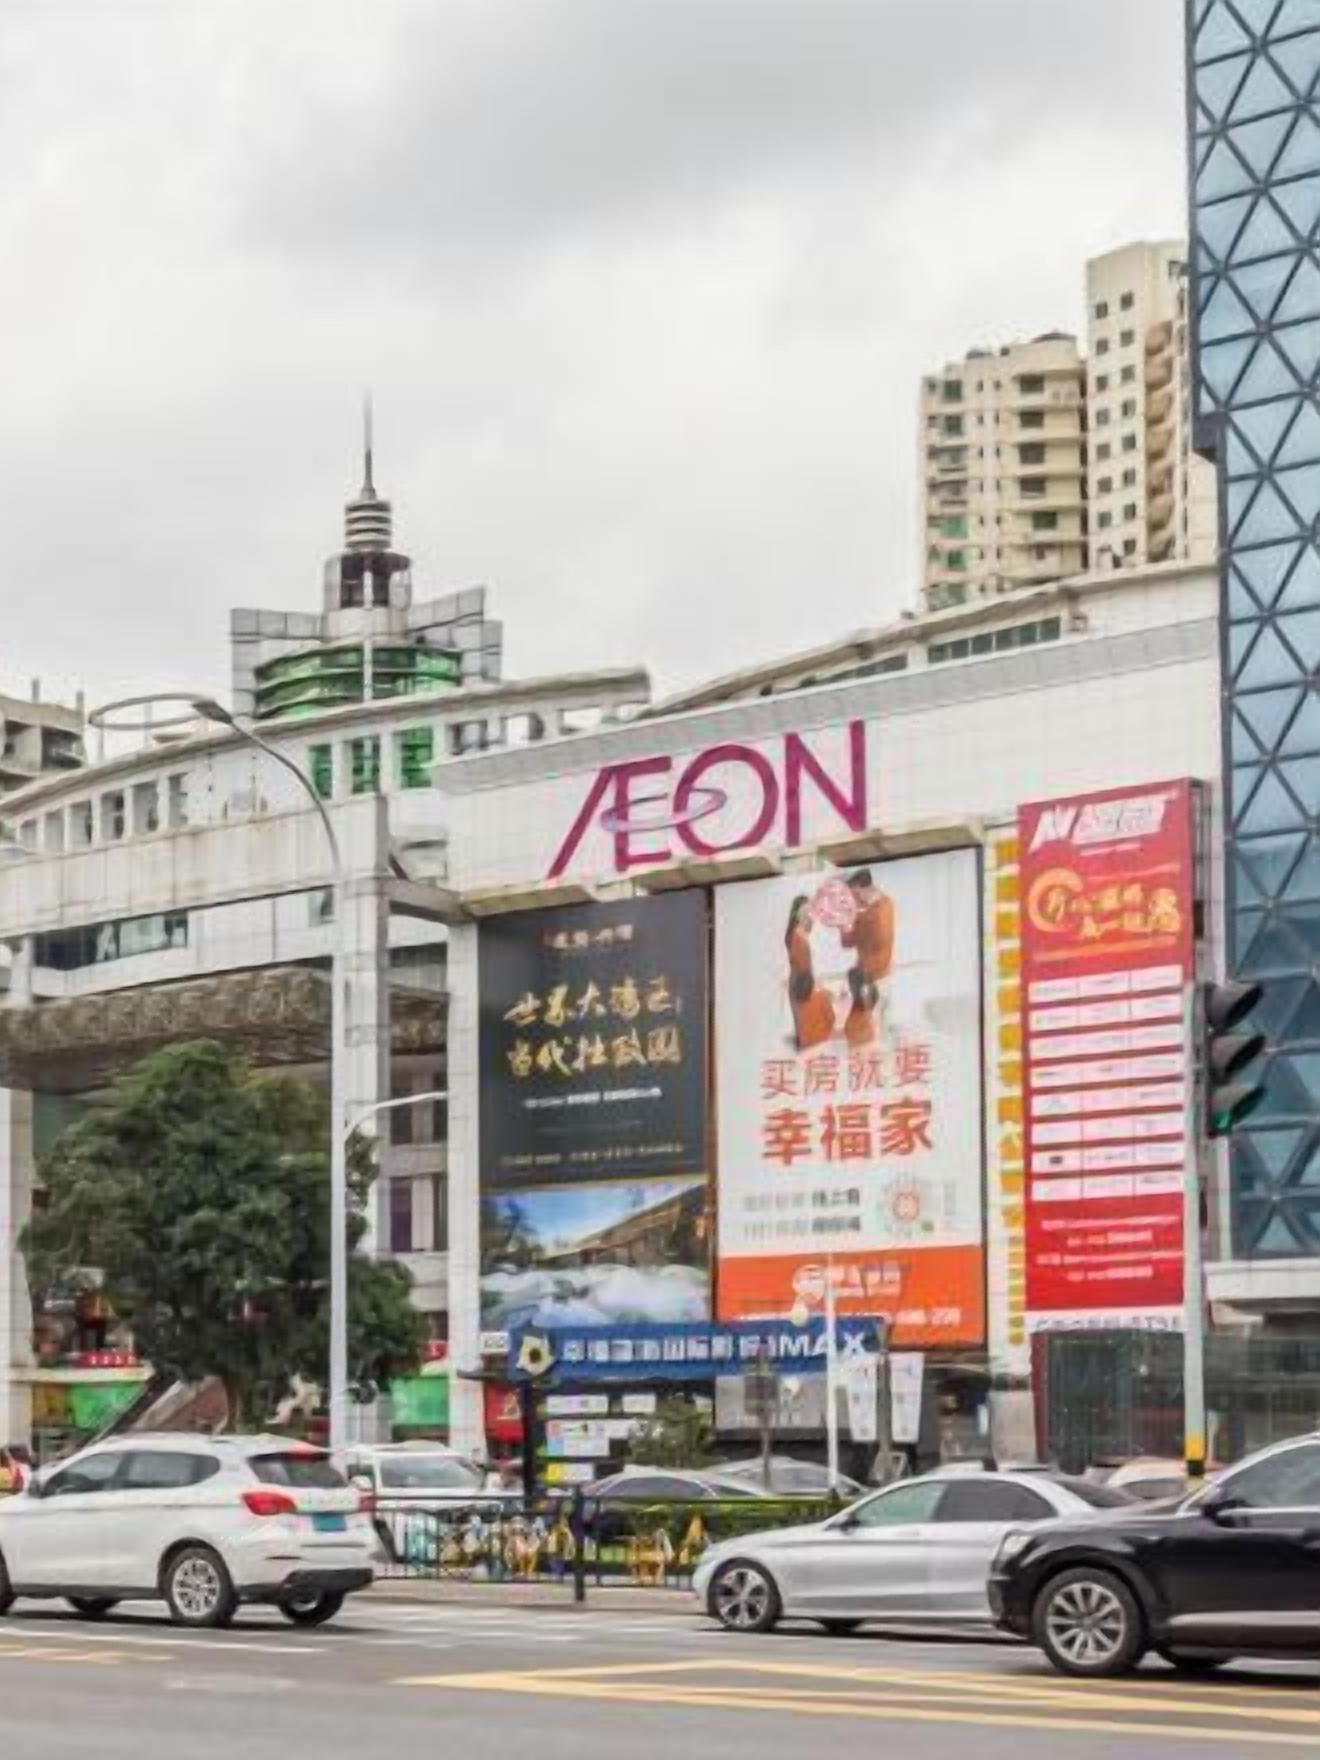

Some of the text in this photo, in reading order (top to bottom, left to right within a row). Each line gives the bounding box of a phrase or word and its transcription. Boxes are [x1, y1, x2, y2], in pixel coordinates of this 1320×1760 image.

[760, 1045, 932, 1099] 买房就要
[761, 1096, 934, 1166] 幸福家
